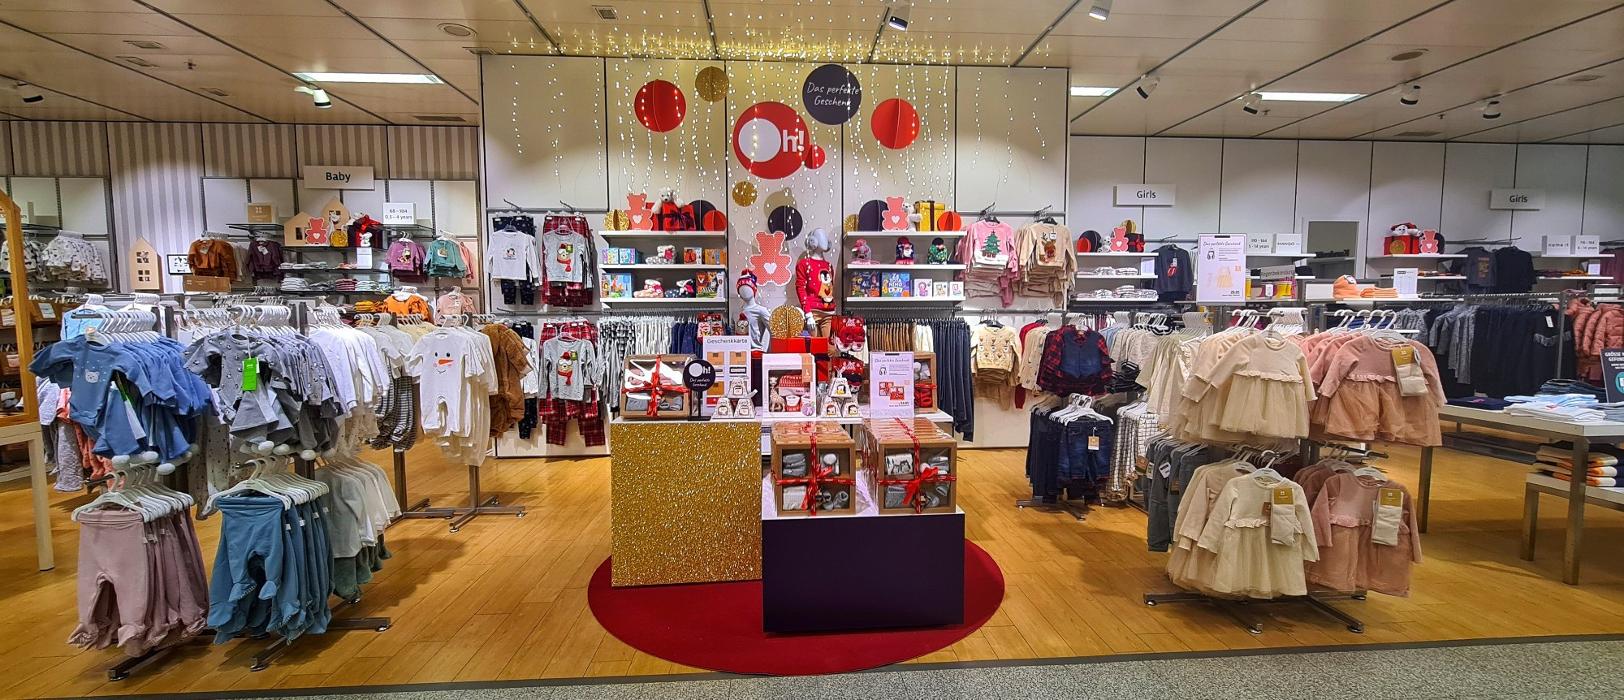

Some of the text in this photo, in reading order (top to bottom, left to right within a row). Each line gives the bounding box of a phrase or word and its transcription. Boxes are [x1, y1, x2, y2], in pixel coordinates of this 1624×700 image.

[807, 82, 860, 95] Das perfekte
[738, 118, 804, 162] Oh!
[325, 171, 351, 183] Baby
[1136, 190, 1156, 198] Girls
[1509, 194, 1528, 203] Girls
[688, 362, 711, 378] Oh!
